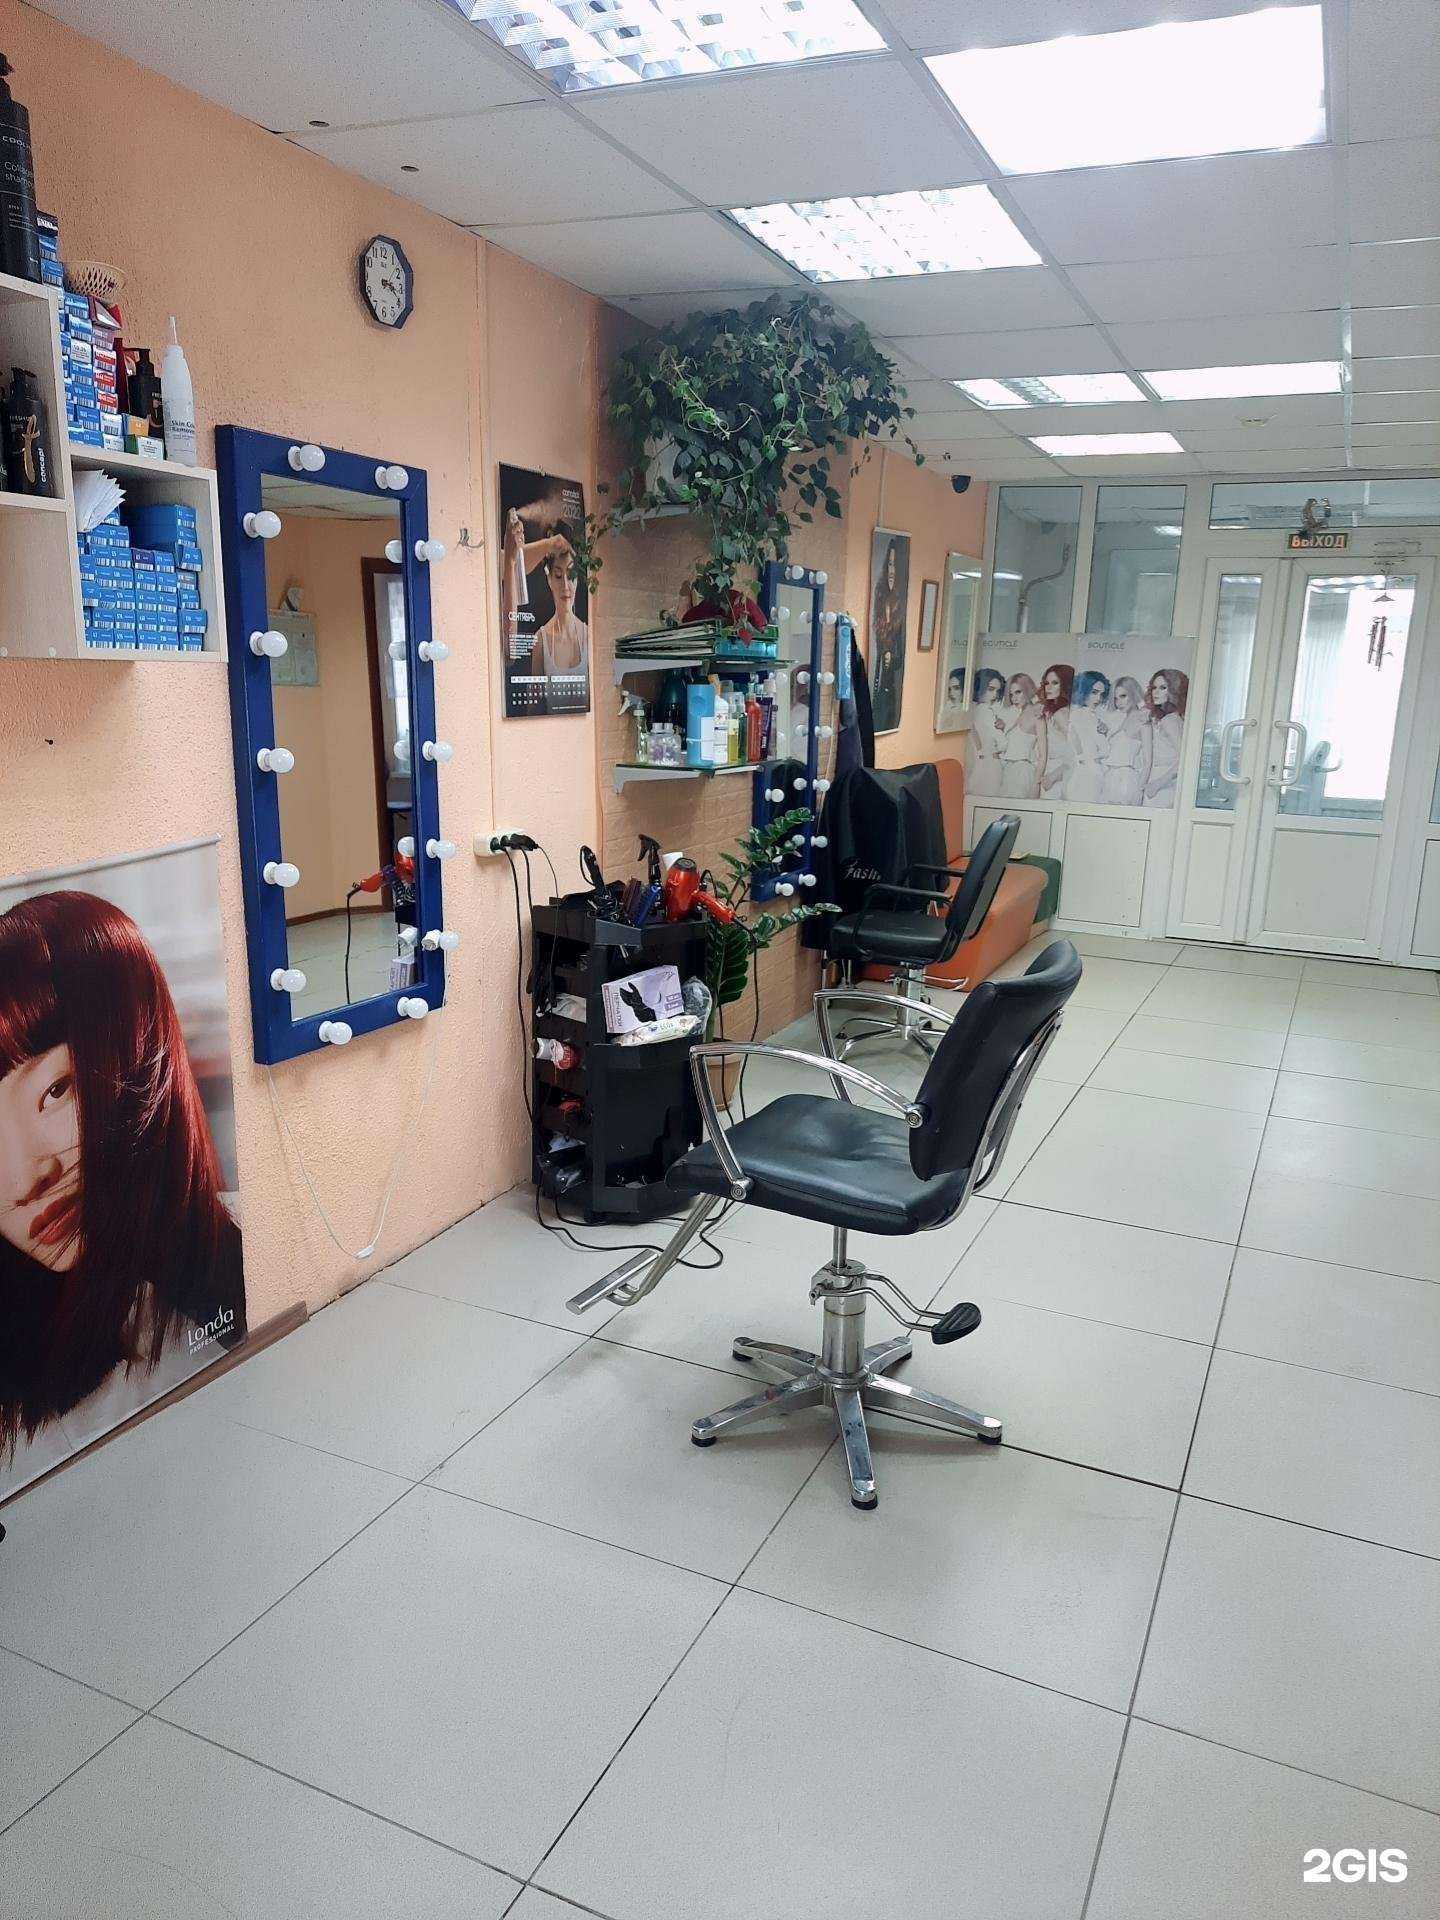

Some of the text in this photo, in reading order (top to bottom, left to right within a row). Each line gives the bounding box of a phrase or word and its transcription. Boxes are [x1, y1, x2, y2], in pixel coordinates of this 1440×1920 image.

[380, 246, 388, 260] 12
[1291, 534, 1345, 548] ВЫХОД
[187, 1304, 234, 1346] Londa
[189, 1323, 234, 1356] PROFESSIONAL
